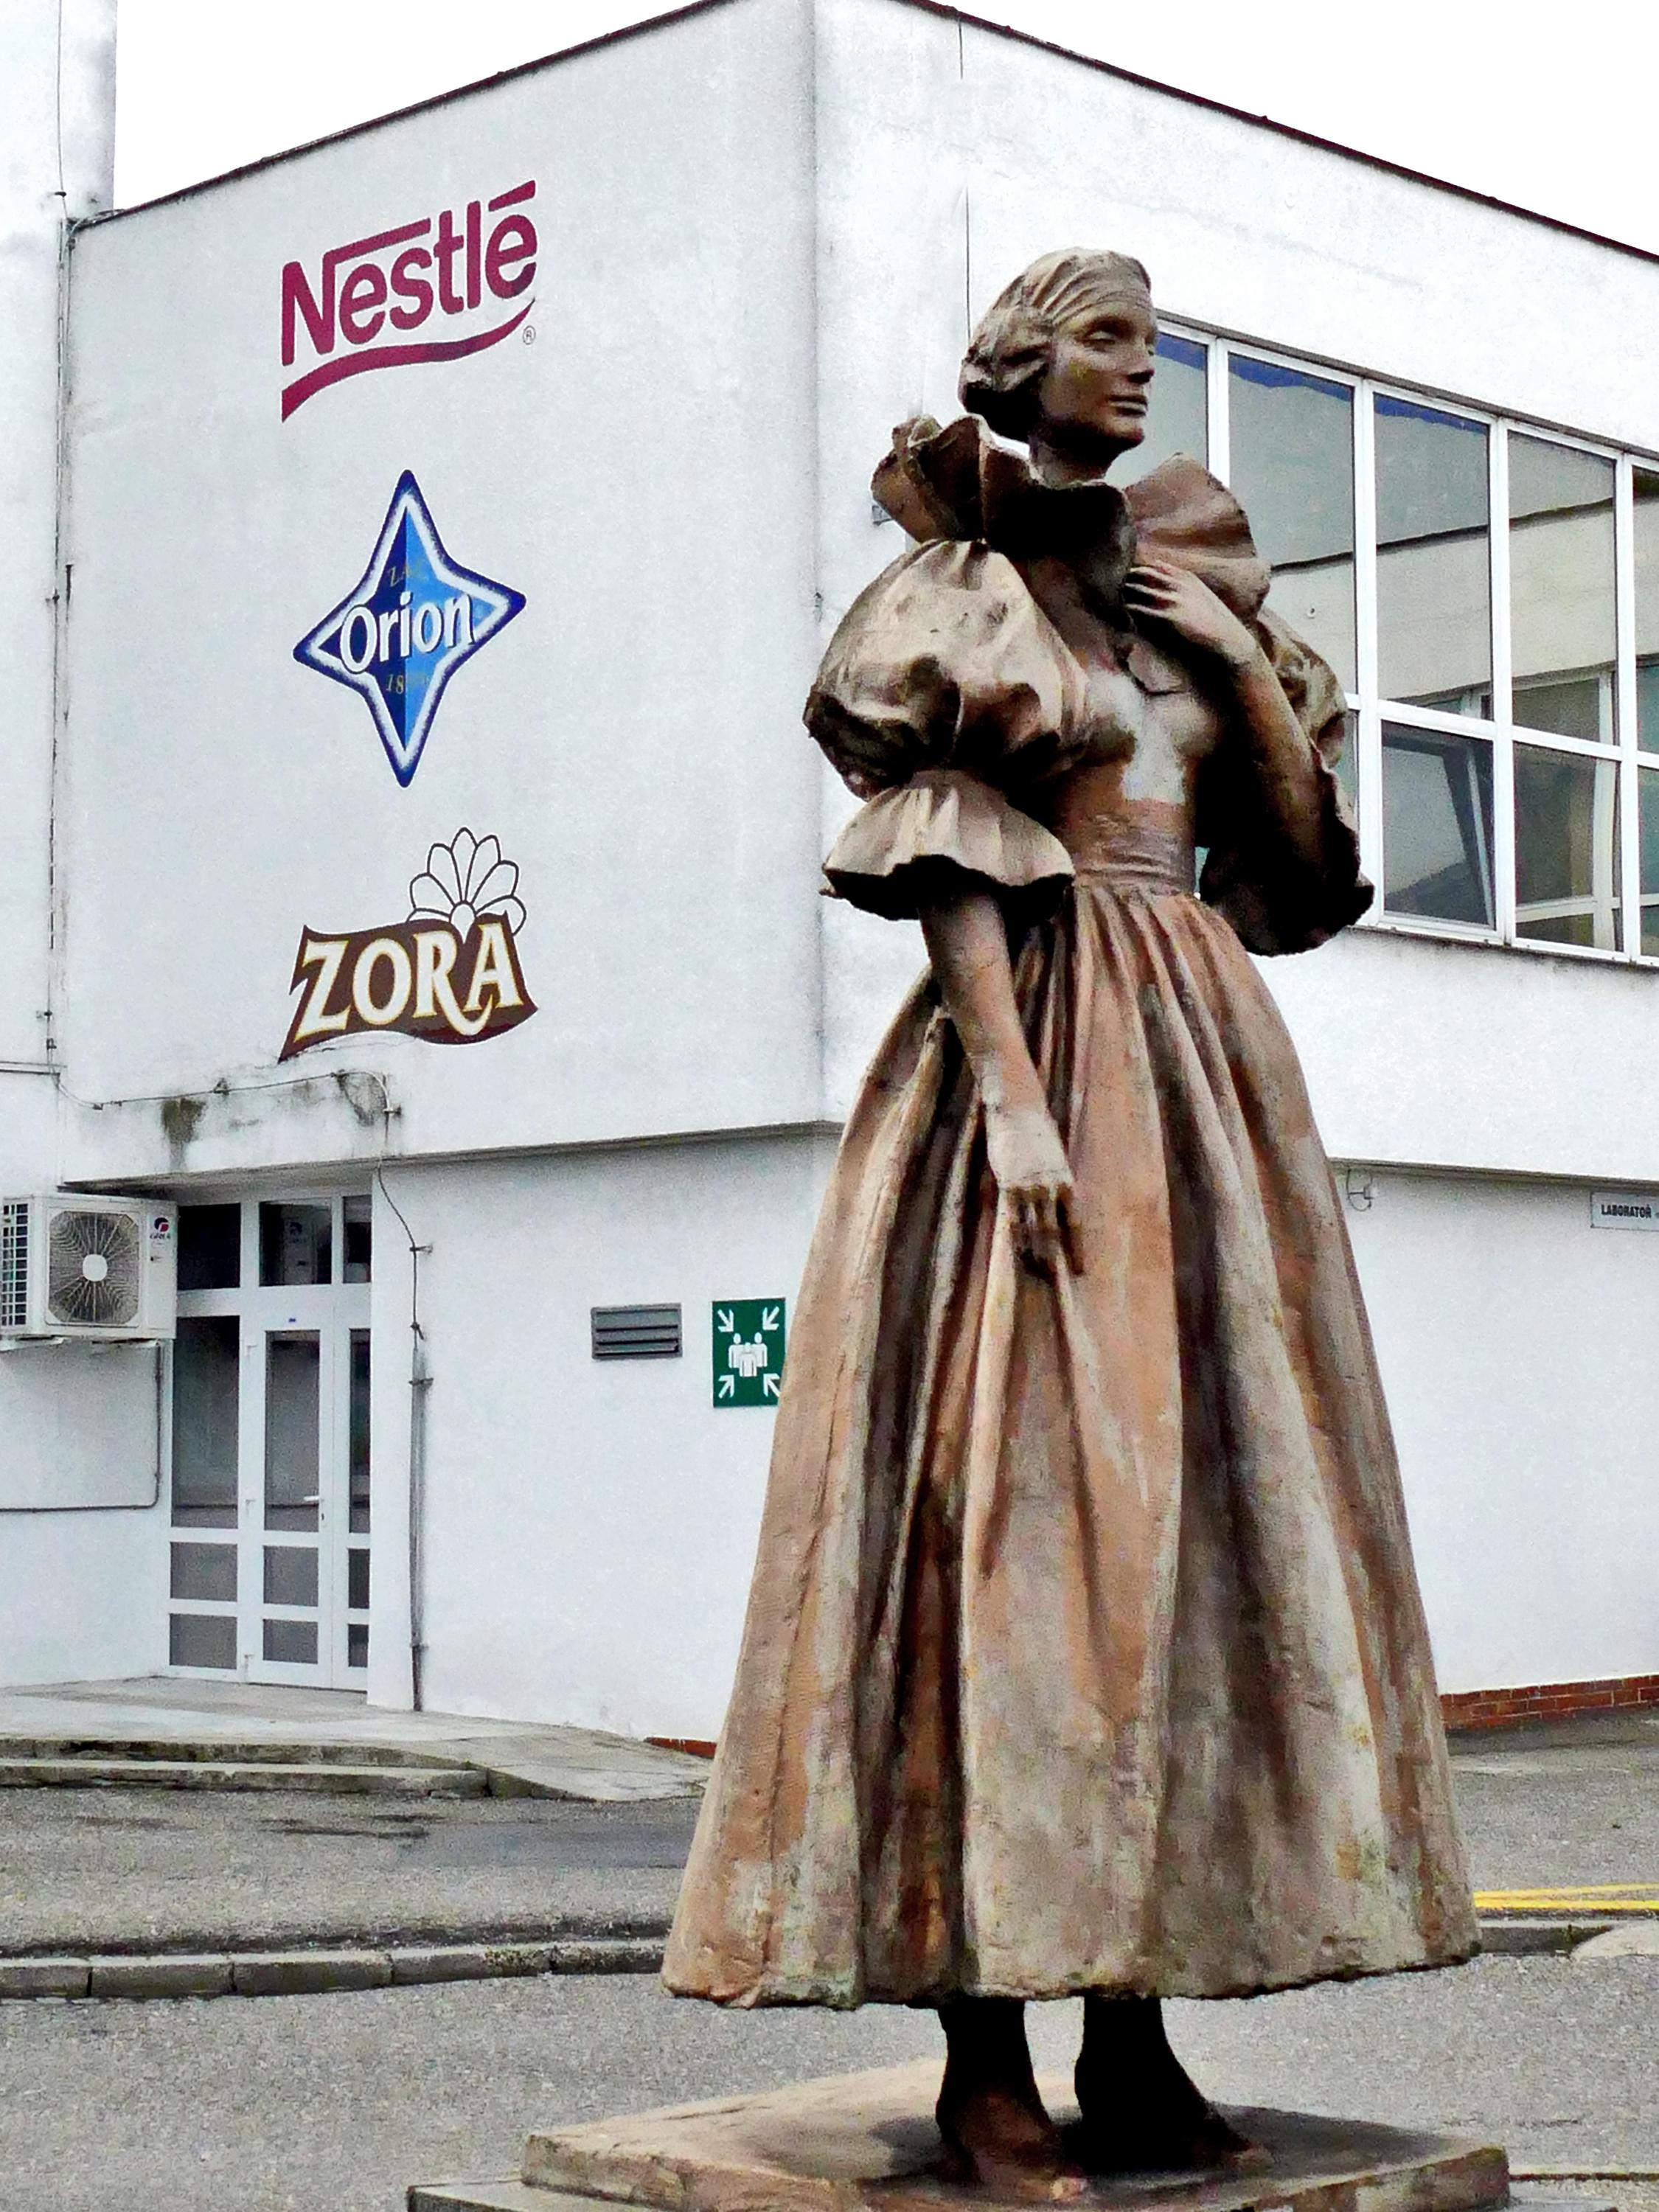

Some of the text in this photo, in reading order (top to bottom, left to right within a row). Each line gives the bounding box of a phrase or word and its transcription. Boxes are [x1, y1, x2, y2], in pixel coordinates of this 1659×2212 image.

[282, 180, 538, 366] Nestlé
[340, 591, 476, 674] Orion
[294, 922, 523, 1041] ZORA
